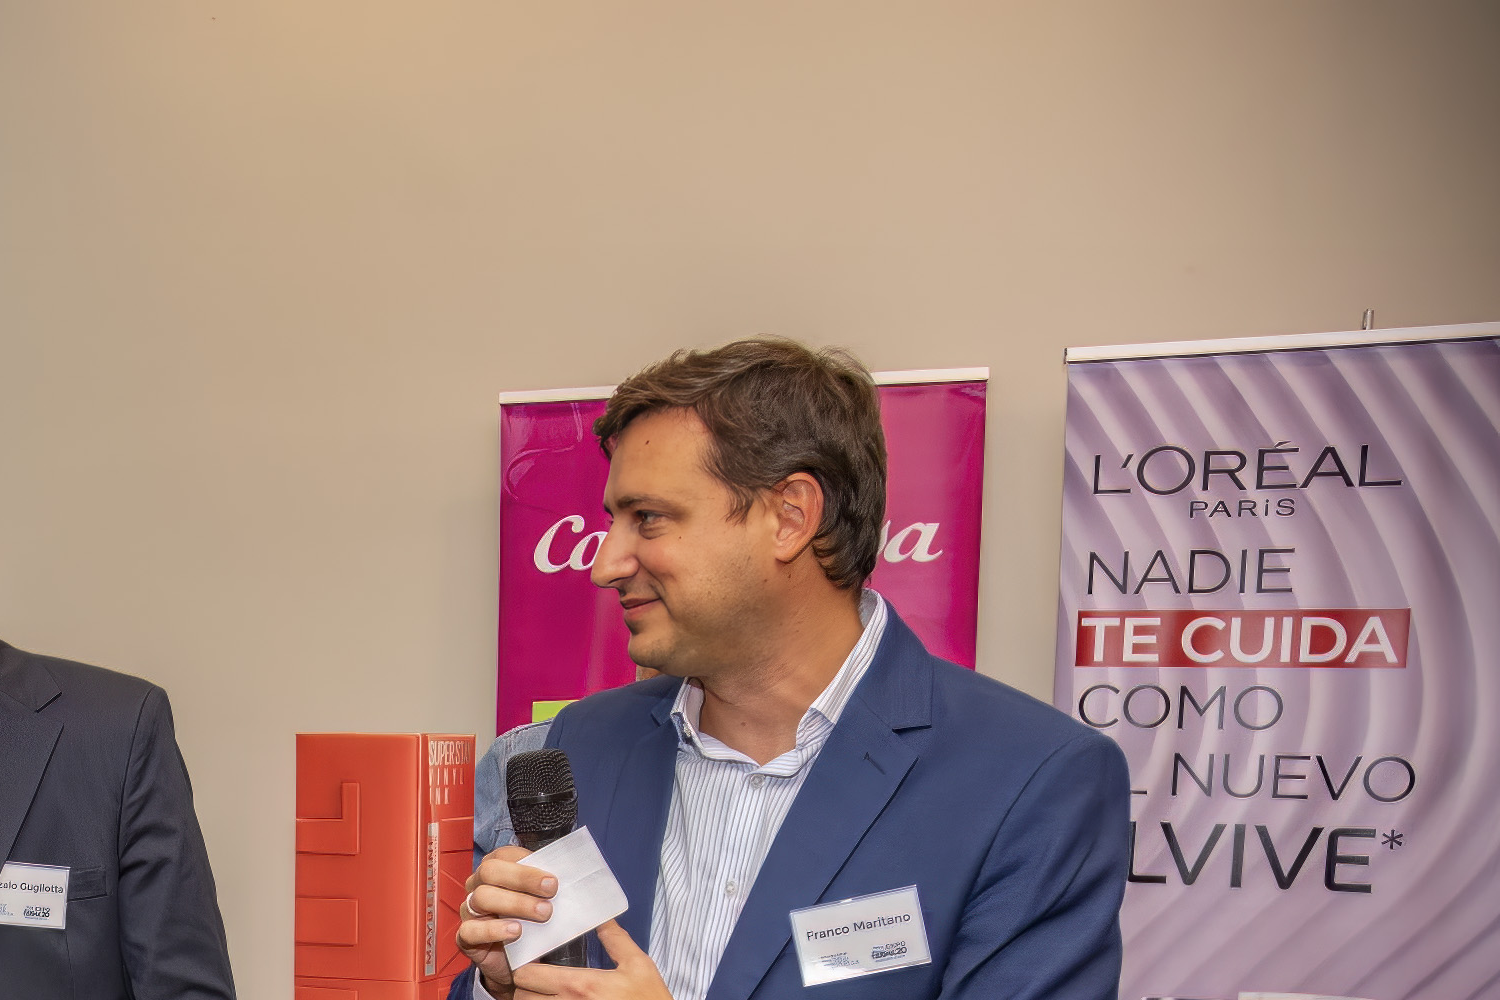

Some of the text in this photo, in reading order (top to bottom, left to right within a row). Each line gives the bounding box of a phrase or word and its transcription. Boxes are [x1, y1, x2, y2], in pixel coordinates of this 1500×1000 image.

[1092, 441, 1404, 495] L'ORÉAL
[1087, 548, 1296, 595] NADIE
[1081, 616, 1399, 663] TE CUIDA
[1078, 684, 1284, 731] COMO
[1171, 752, 1416, 803] NUEVO
[1127, 820, 1404, 893] LVIVE
[806, 913, 911, 941] Franco Maritano
